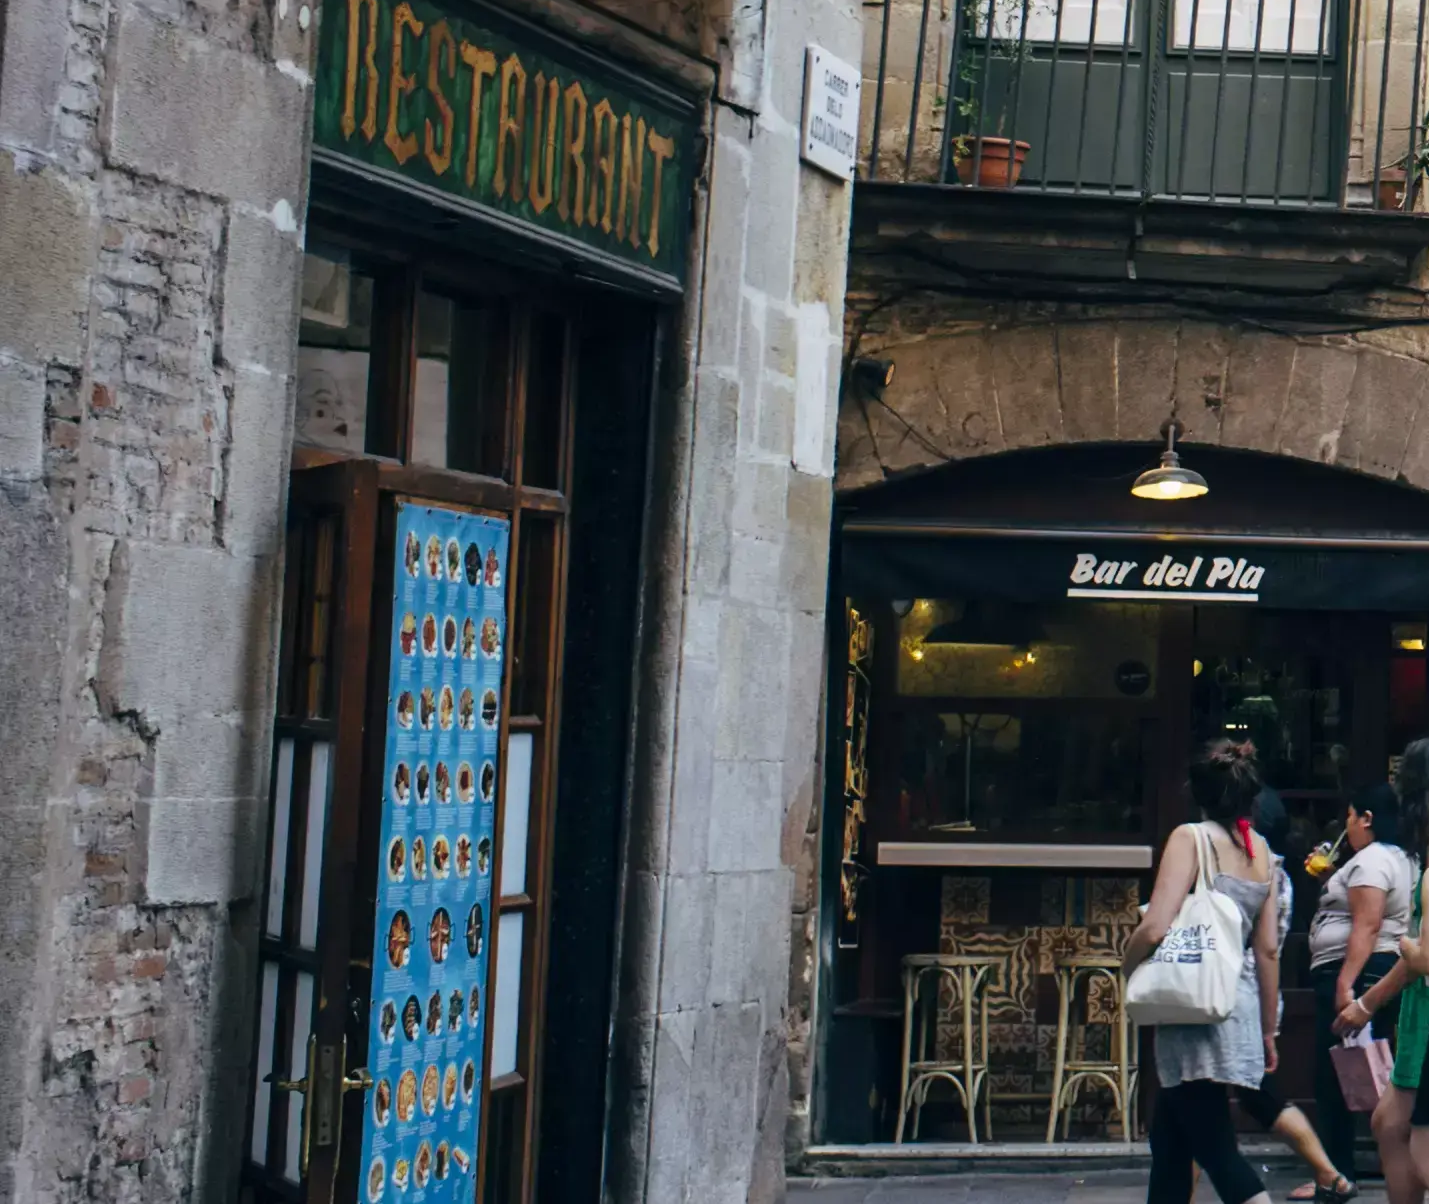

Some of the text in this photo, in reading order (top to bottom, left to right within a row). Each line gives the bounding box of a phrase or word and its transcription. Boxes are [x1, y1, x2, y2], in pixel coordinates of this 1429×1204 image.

[1070, 553, 1265, 590] Bar del Pla
